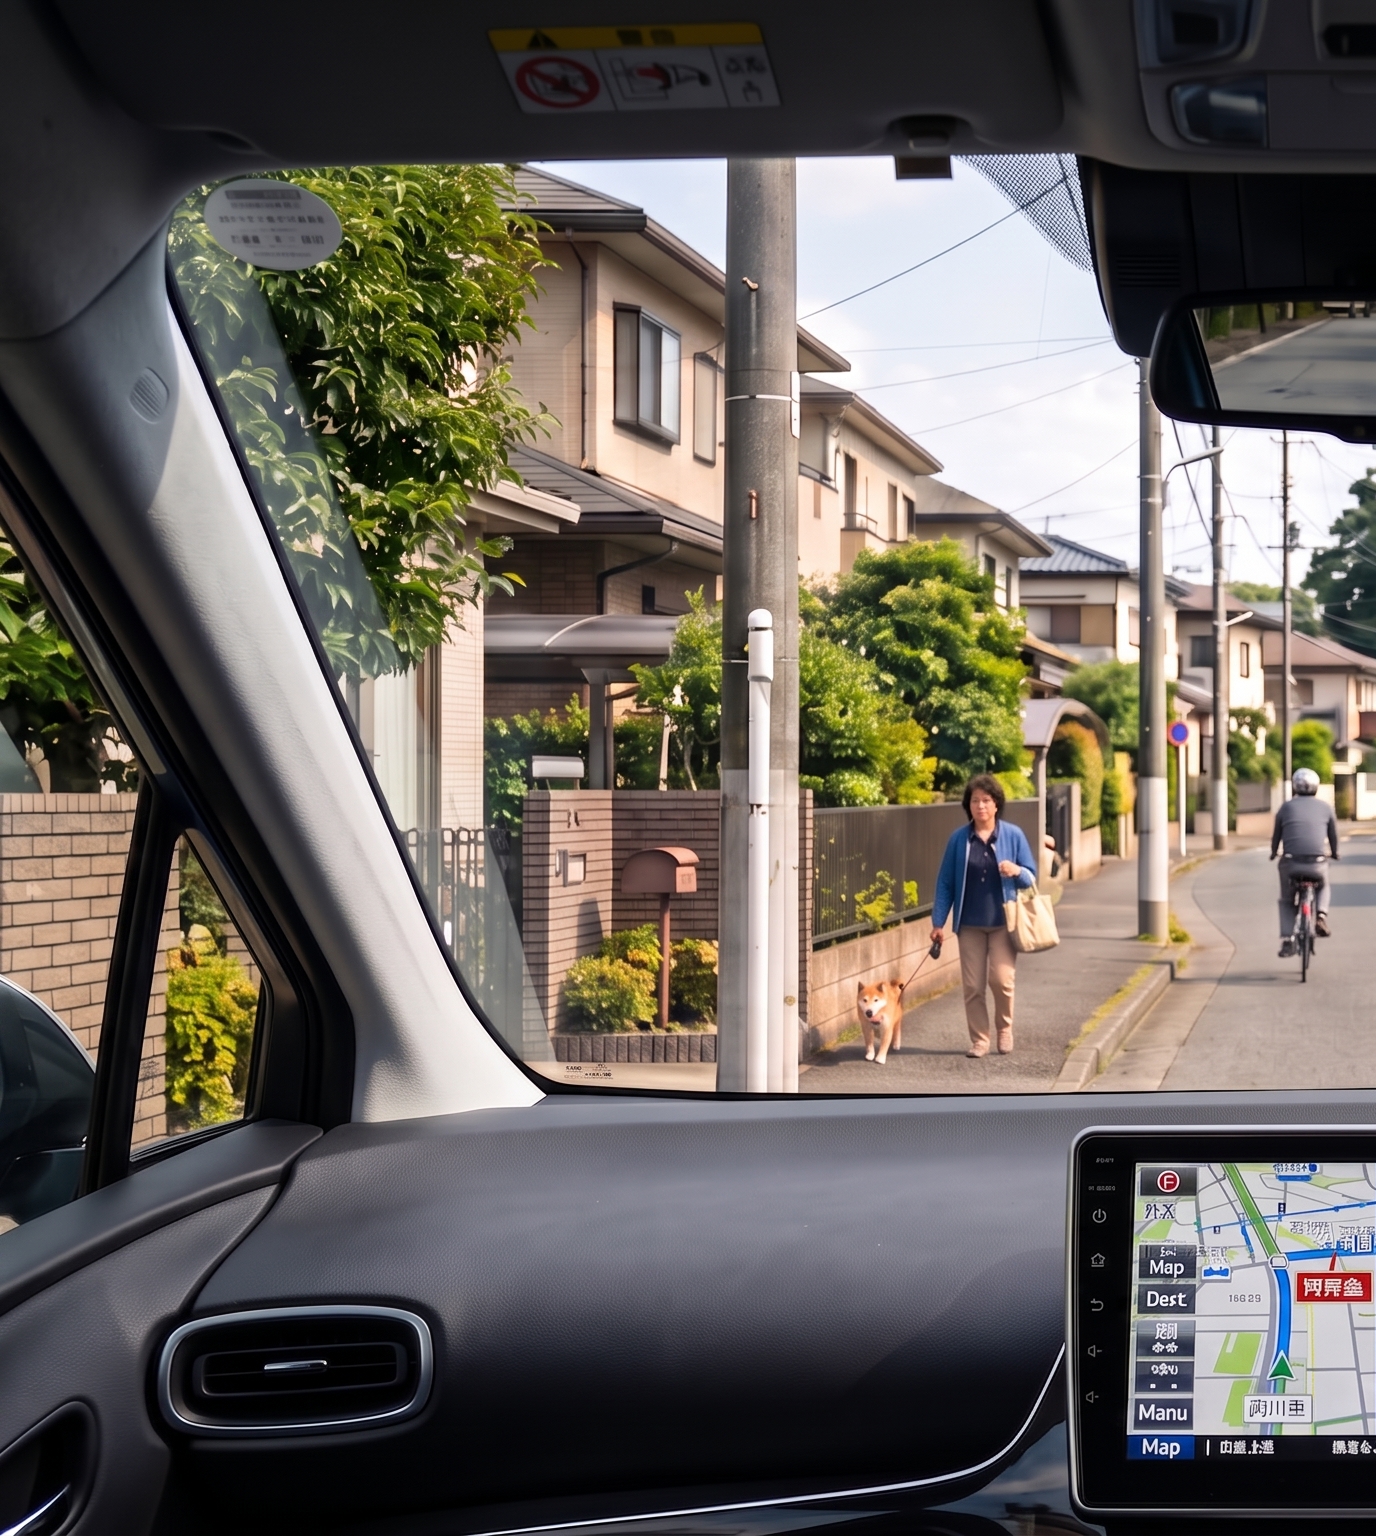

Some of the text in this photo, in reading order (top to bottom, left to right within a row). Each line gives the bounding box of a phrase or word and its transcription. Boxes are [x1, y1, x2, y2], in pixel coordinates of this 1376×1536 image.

[1149, 1259, 1185, 1278] Map
[1146, 1290, 1188, 1307] Dest
[1138, 1403, 1188, 1421] Manu
[1142, 1438, 1181, 1459] Map
